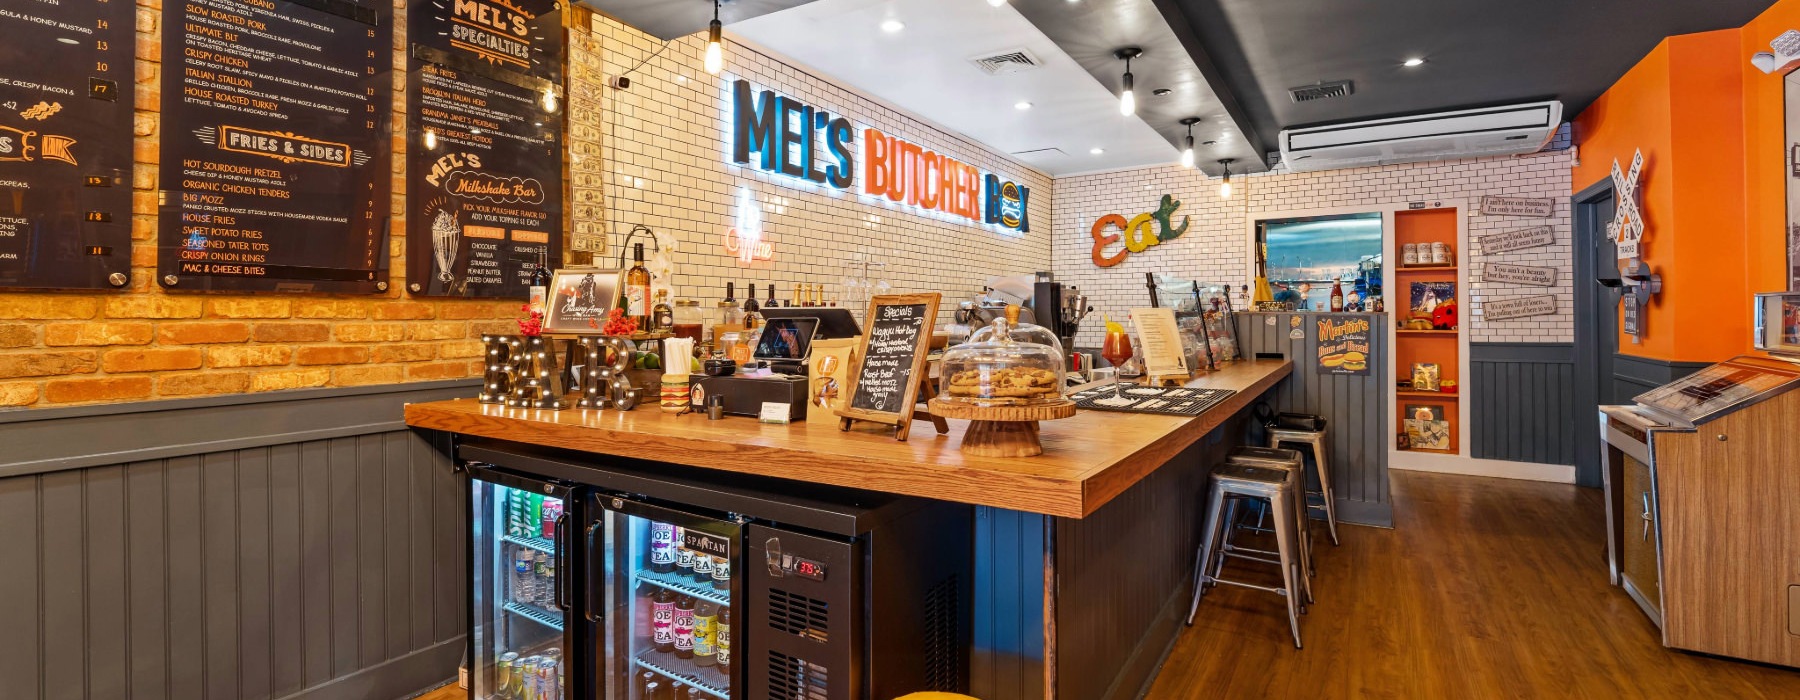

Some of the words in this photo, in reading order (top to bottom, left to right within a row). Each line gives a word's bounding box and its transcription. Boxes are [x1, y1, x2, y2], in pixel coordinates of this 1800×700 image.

[30, 16, 57, 26] HONEY
[59, 22, 93, 34] MUSTARD
[97, 20, 108, 29] 14
[186, 4, 208, 16] SLOW
[212, 10, 245, 25] ROASTED
[248, 20, 266, 31] PORK
[454, 0, 528, 36] MEL'S
[186, 22, 222, 38] ULTIMATE
[226, 32, 238, 42] BLT
[452, 24, 528, 58] SPECIALTIES
[97, 40, 108, 50] 13
[97, 62, 108, 72] 10
[185, 48, 212, 60] CRISPY
[214, 54, 248, 68] CHICKEN
[12, 80, 40, 90] CRISPY
[42, 85, 68, 94] BACON
[186, 68, 214, 80] ITALIAN
[218, 74, 252, 88] STALLION
[184, 86, 213, 98] HOUSE
[216, 92, 250, 106] ROASTED
[252, 100, 278, 111] TURKEY
[230, 132, 278, 152] FRIES
[284, 142, 294, 154] &
[300, 144, 343, 162] SIDES
[732, 79, 854, 190] MEL'S
[864, 128, 981, 221] BUTCHER
[184, 160, 201, 168] HOT
[203, 162, 252, 176] SOURDOUGH
[254, 168, 282, 178] PRETZEL
[426, 152, 482, 187] MEL'S
[182, 180, 220, 192] ORGANIC
[222, 184, 256, 195] CHICKEN
[258, 188, 290, 198] TENDERS
[456, 178, 510, 196] Milkshake
[513, 184, 536, 197] Bar
[183, 192, 197, 202] BIG
[200, 196, 224, 204] MOZZ
[182, 213, 211, 222] HOUSE
[214, 216, 236, 225] FRIES
[182, 226, 209, 236] SWEET
[212, 228, 239, 237] POTATO
[242, 230, 262, 239] FRIES
[1091, 194, 1190, 267] Eat
[1625, 228, 1629, 239] 2
[182, 239, 225, 248] SEASONED
[228, 242, 250, 250] TATER
[252, 242, 270, 252] TOTS
[1620, 244, 1635, 253] TRACKS
[182, 250, 208, 260] CRISPY
[210, 252, 239, 261] ONION
[242, 254, 265, 262] RINGS
[182, 264, 202, 272] MAC
[212, 265, 242, 274] CHEESE
[244, 266, 265, 274] BITES
[884, 306, 912, 318] Specials
[896, 325, 905, 335] Hot
[905, 328, 917, 340] Dog
[1318, 319, 1368, 341] Martin's
[1348, 341, 1369, 353] Bread
[480, 334, 643, 411] BAR
[687, 535, 725, 554] SPARTAN
